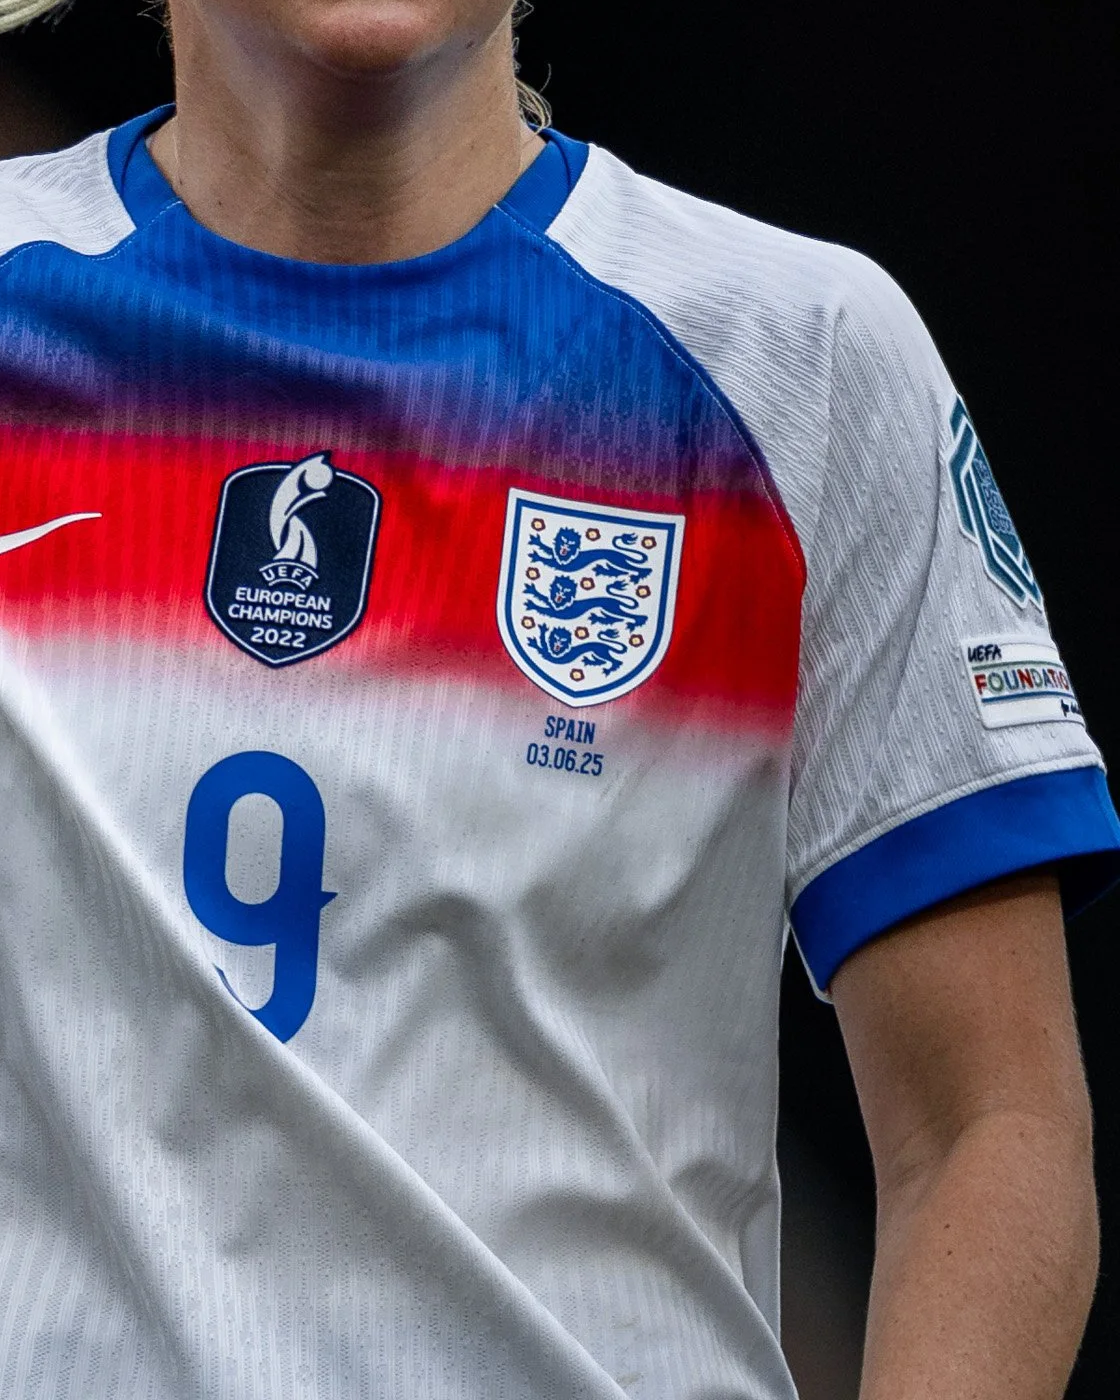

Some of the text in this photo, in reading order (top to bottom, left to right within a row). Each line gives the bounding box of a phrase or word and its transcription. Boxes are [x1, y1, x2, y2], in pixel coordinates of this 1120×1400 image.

[262, 566, 313, 587] UEFA
[235, 587, 331, 611] EUROPEAN
[228, 603, 333, 629] CHAMPIONS
[250, 626, 306, 648] 2022
[968, 644, 1002, 662] UEFA
[544, 715, 596, 744] SPAIN
[526, 743, 604, 776] 03.06.25
[183, 750, 339, 1044] 9
